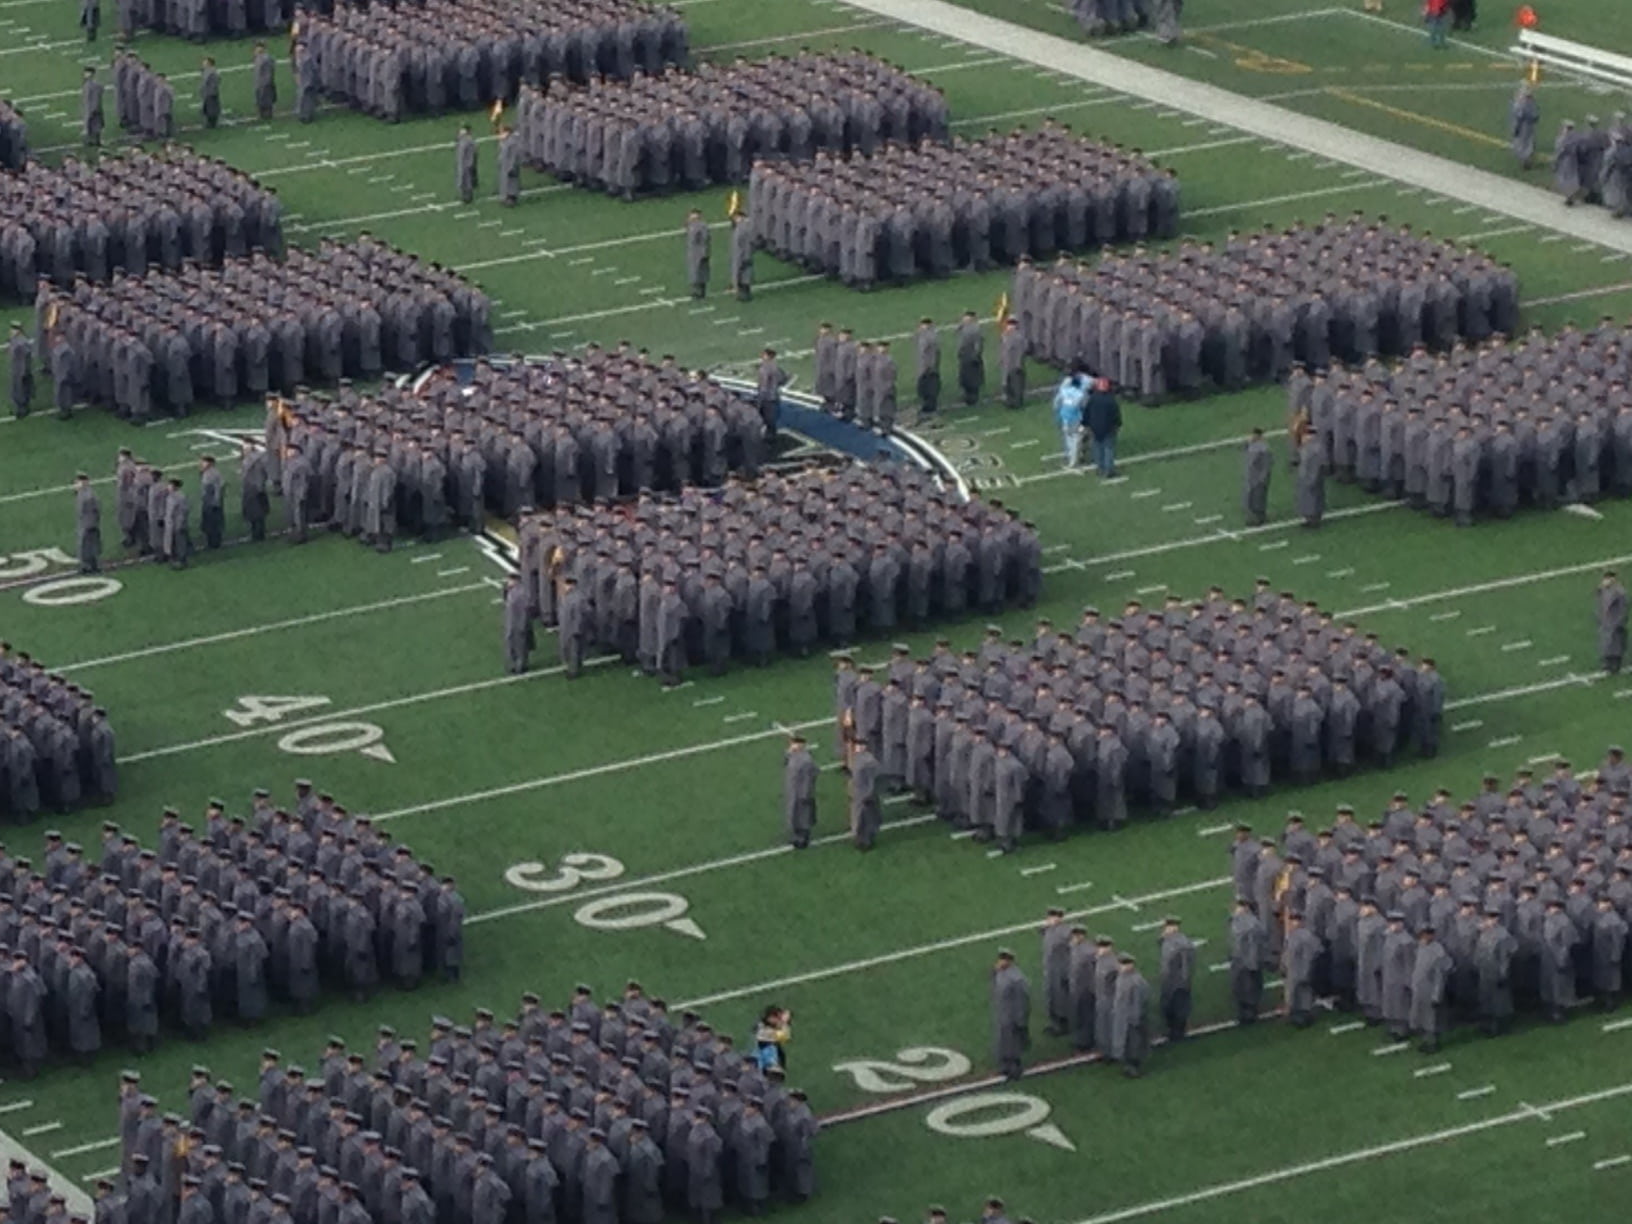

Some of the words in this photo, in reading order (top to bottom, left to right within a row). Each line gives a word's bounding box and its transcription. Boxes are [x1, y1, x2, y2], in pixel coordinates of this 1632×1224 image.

[223, 694, 385, 756] 40
[504, 852, 689, 931] 30
[833, 1047, 1051, 1138] 20
